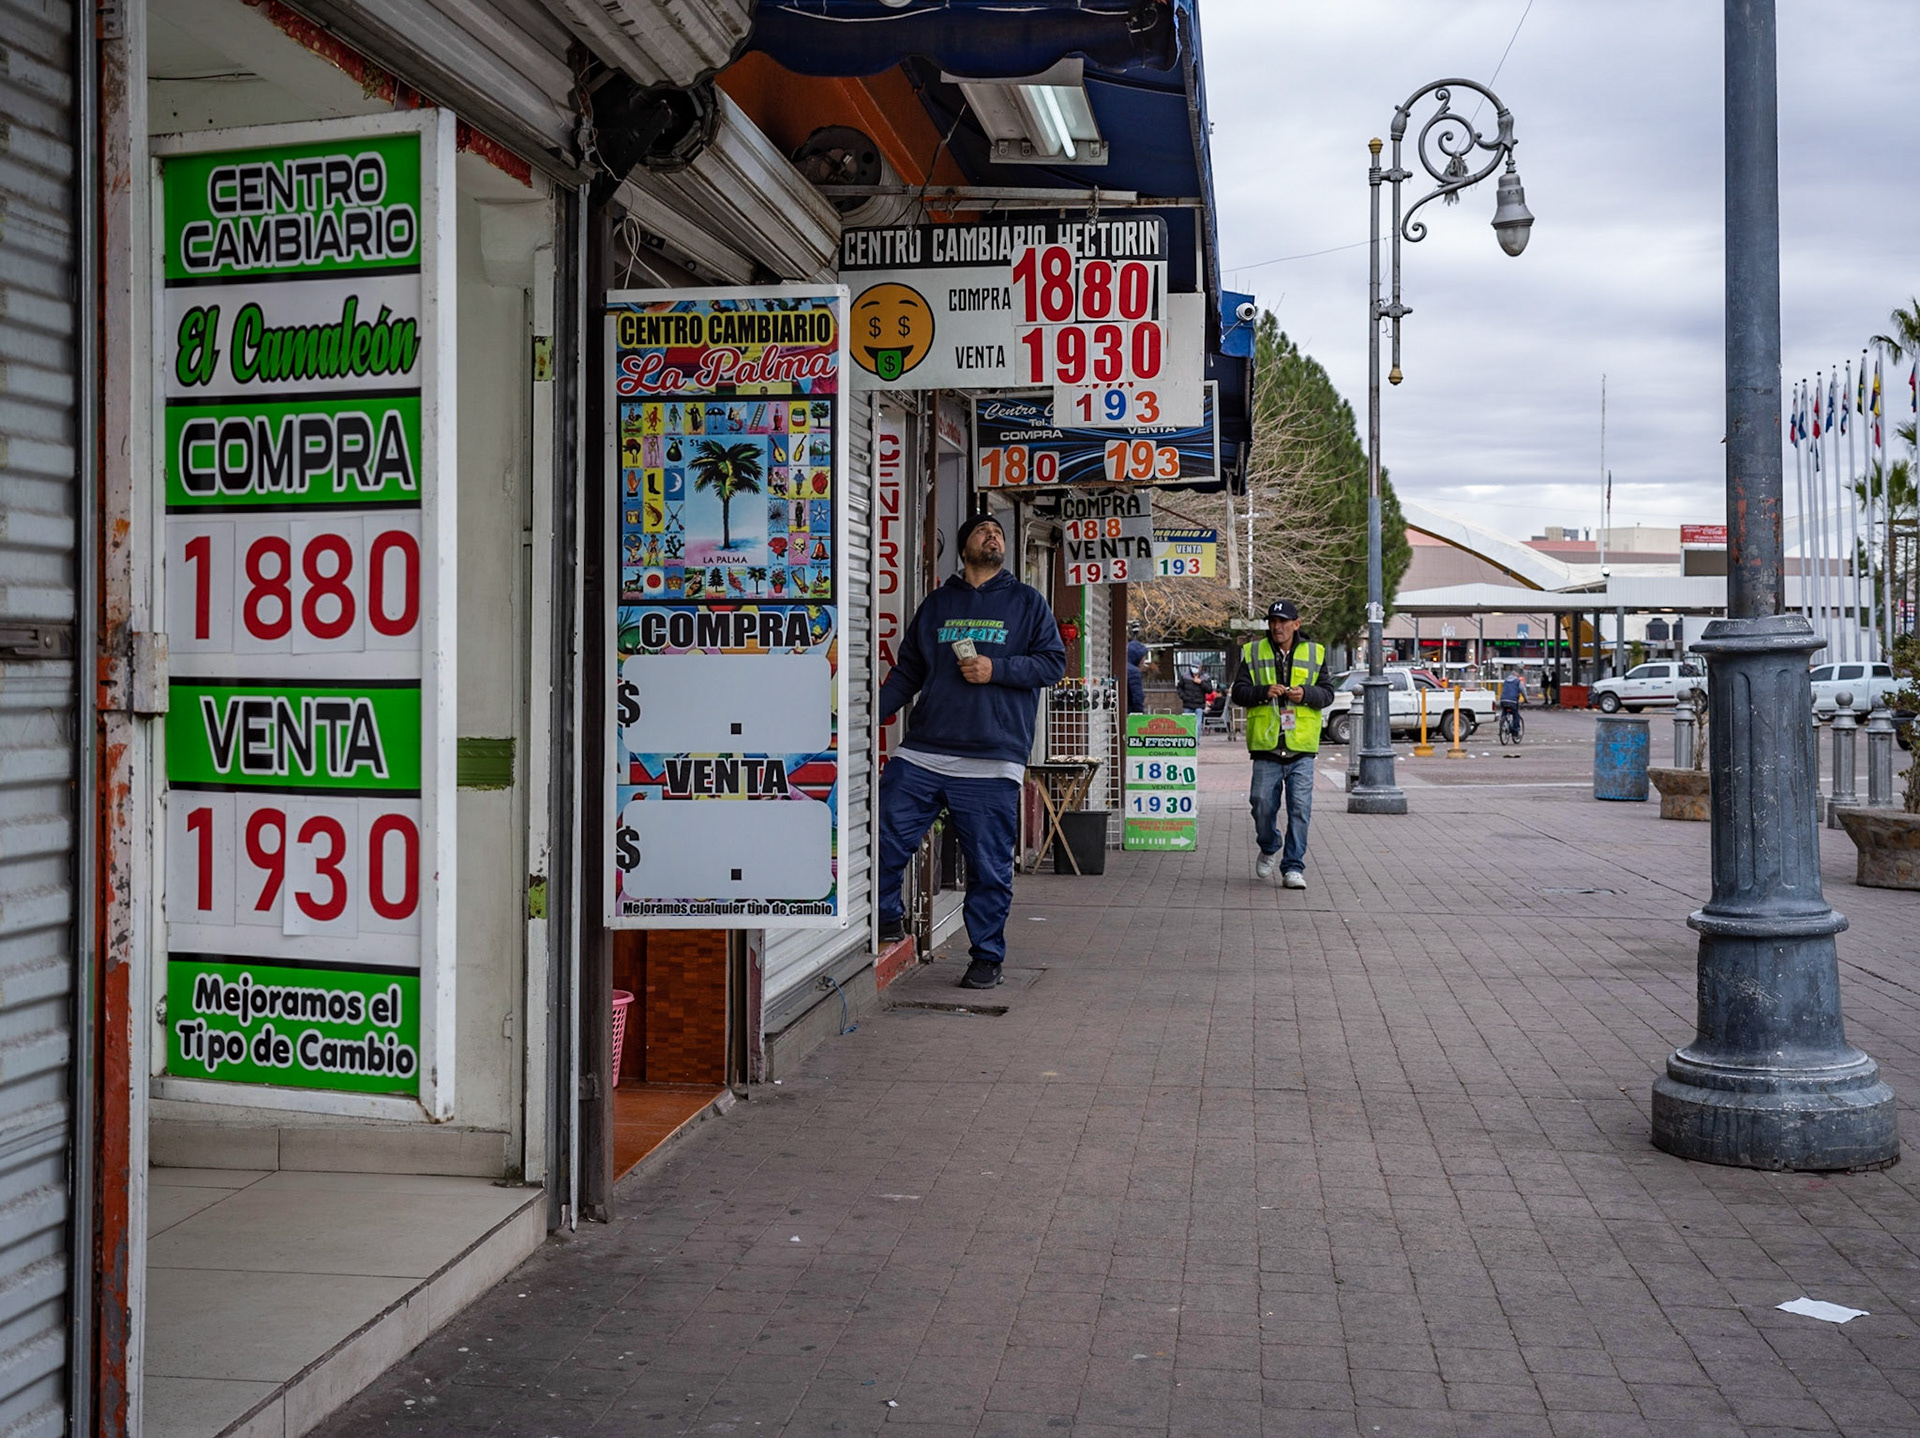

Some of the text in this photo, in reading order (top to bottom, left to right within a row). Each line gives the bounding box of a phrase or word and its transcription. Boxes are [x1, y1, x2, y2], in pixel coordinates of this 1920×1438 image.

[209, 153, 386, 217] CENTRO
[182, 205, 416, 271] CAMBIARIO
[845, 229, 921, 265] CENTRO
[949, 287, 1011, 311] COMPRA
[176, 295, 420, 386] El Camaleón
[621, 313, 831, 345] CENTRO CAMBIARIO
[616, 343, 836, 396] La Palma
[956, 345, 1005, 369] VENTA
[1022, 321, 1161, 385] 1930
[984, 403, 1037, 420] Centro
[1076, 389, 1160, 424] 193
[180, 410, 416, 496] COMPRA
[1000, 430, 1063, 441] COMPRA
[1107, 440, 1180, 481] 193
[1064, 495, 1140, 518] COMPRA
[703, 556, 748, 564] LA PALMA
[1068, 536, 1152, 560] VENTA
[1176, 545, 1202, 554] VENTA
[1160, 558, 1200, 575] 193
[185, 530, 420, 641] 1880
[640, 611, 812, 649] COMPRA
[200, 696, 389, 779] VENTA
[1129, 737, 1195, 747] EL EFECTIVO
[664, 757, 790, 795] VENTA
[1134, 796, 1192, 813] 1930
[187, 807, 420, 922] 1930
[623, 901, 832, 916] Mejoramos cualquier tipo de cambio
[193, 971, 400, 1027] Mejoramos el
[177, 1022, 416, 1078] Tipo de Cambio
